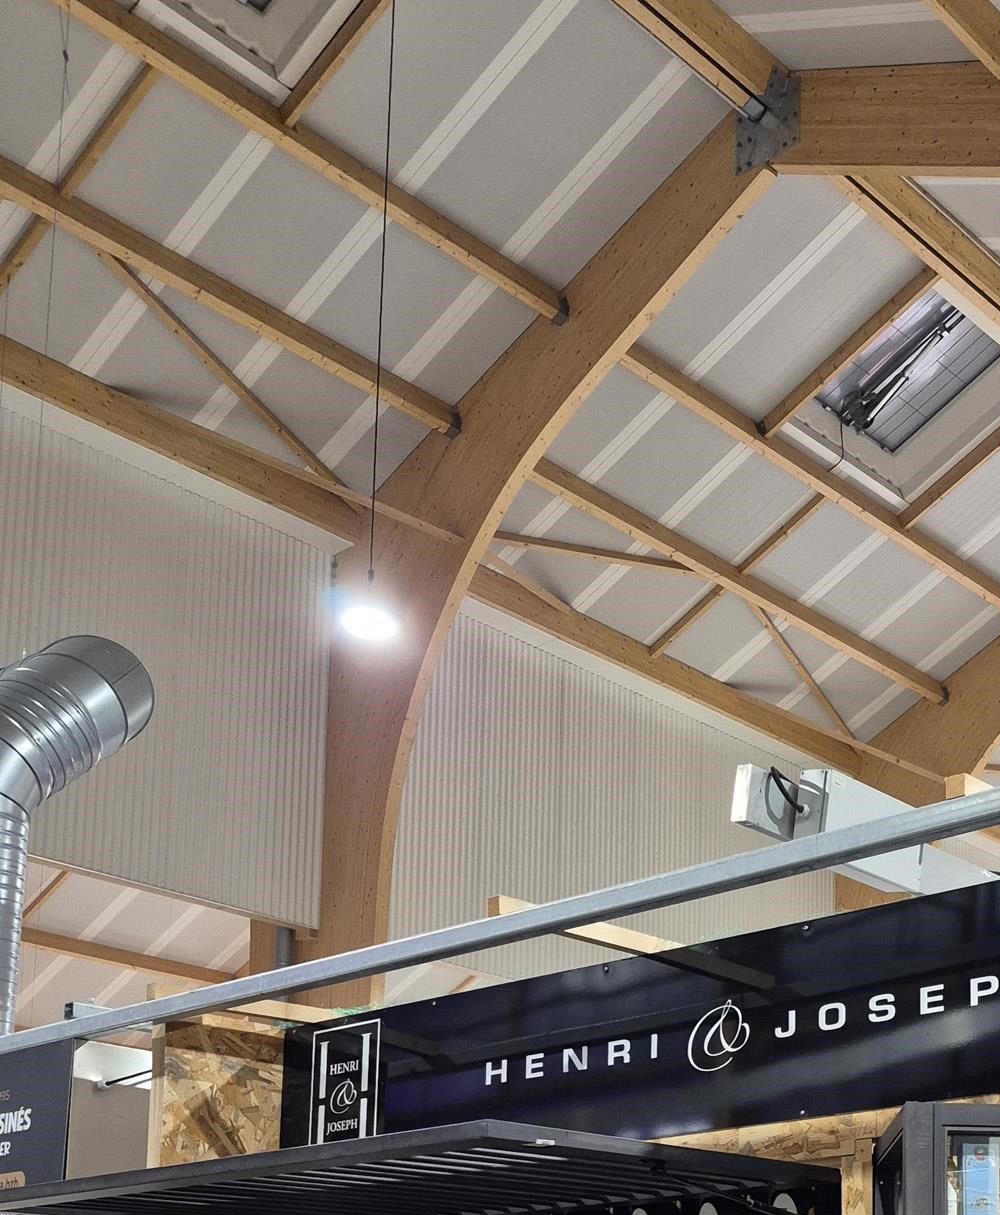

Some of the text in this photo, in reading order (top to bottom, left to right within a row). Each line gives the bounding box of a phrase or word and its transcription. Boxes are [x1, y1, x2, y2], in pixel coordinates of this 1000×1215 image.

[330, 1060, 359, 1076] HENRI
[485, 1033, 659, 1086] HENRI
[326, 1118, 358, 1136] JOSEPH
